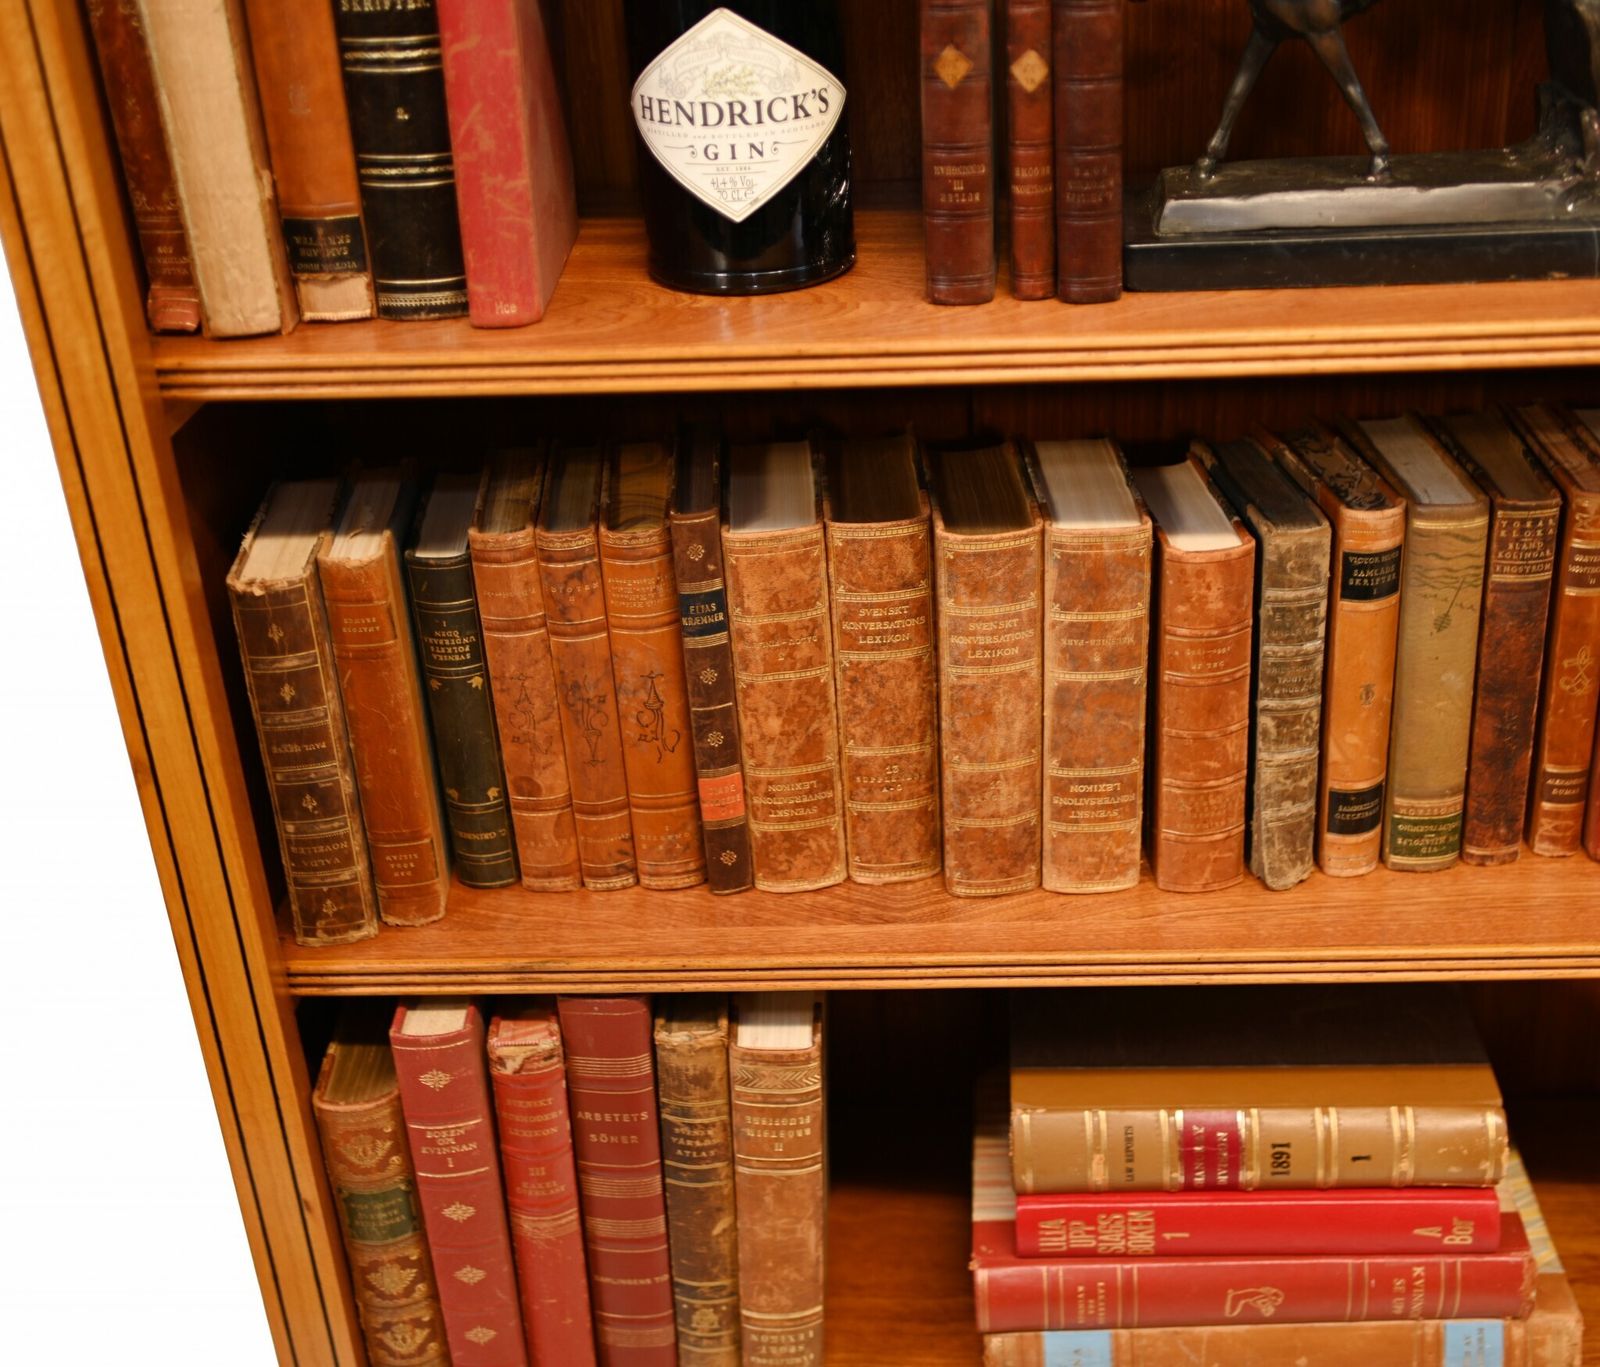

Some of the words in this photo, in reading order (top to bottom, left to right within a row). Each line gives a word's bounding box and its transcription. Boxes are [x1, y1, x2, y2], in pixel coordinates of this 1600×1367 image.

[640, 87, 829, 127] HENDRICK'S
[704, 141, 765, 161] GIN
[689, 602, 717, 615] ELIAS
[859, 605, 910, 617] SVENSKT
[842, 616, 926, 630] KONVERSATIONS
[969, 618, 1019, 630] SVENSKT
[858, 632, 910, 644] LEXIKON
[951, 629, 1034, 645] KONVERSATIONS
[967, 646, 1019, 659] LEXIKON
[768, 780, 817, 792] LEXIKON
[1070, 783, 1121, 793] LEXIKON
[1053, 793, 1136, 806] KONVERSATIONS
[769, 806, 818, 818] SVENSKT
[1069, 808, 1119, 818] SVENSKT
[576, 1111, 649, 1122] ARBETETS
[589, 1133, 640, 1144] SÖNER
[1271, 1141, 1291, 1177] 1891
[1351, 1154, 1372, 1162] 1
[1039, 1218, 1067, 1252] LILLA
[1069, 1220, 1096, 1248] UPP
[1098, 1213, 1125, 1254] SLAGS
[1128, 1210, 1155, 1255] BOKEN
[1162, 1231, 1190, 1240] 1
[1412, 1226, 1442, 1238] A
[1443, 1217, 1474, 1245] Bor
